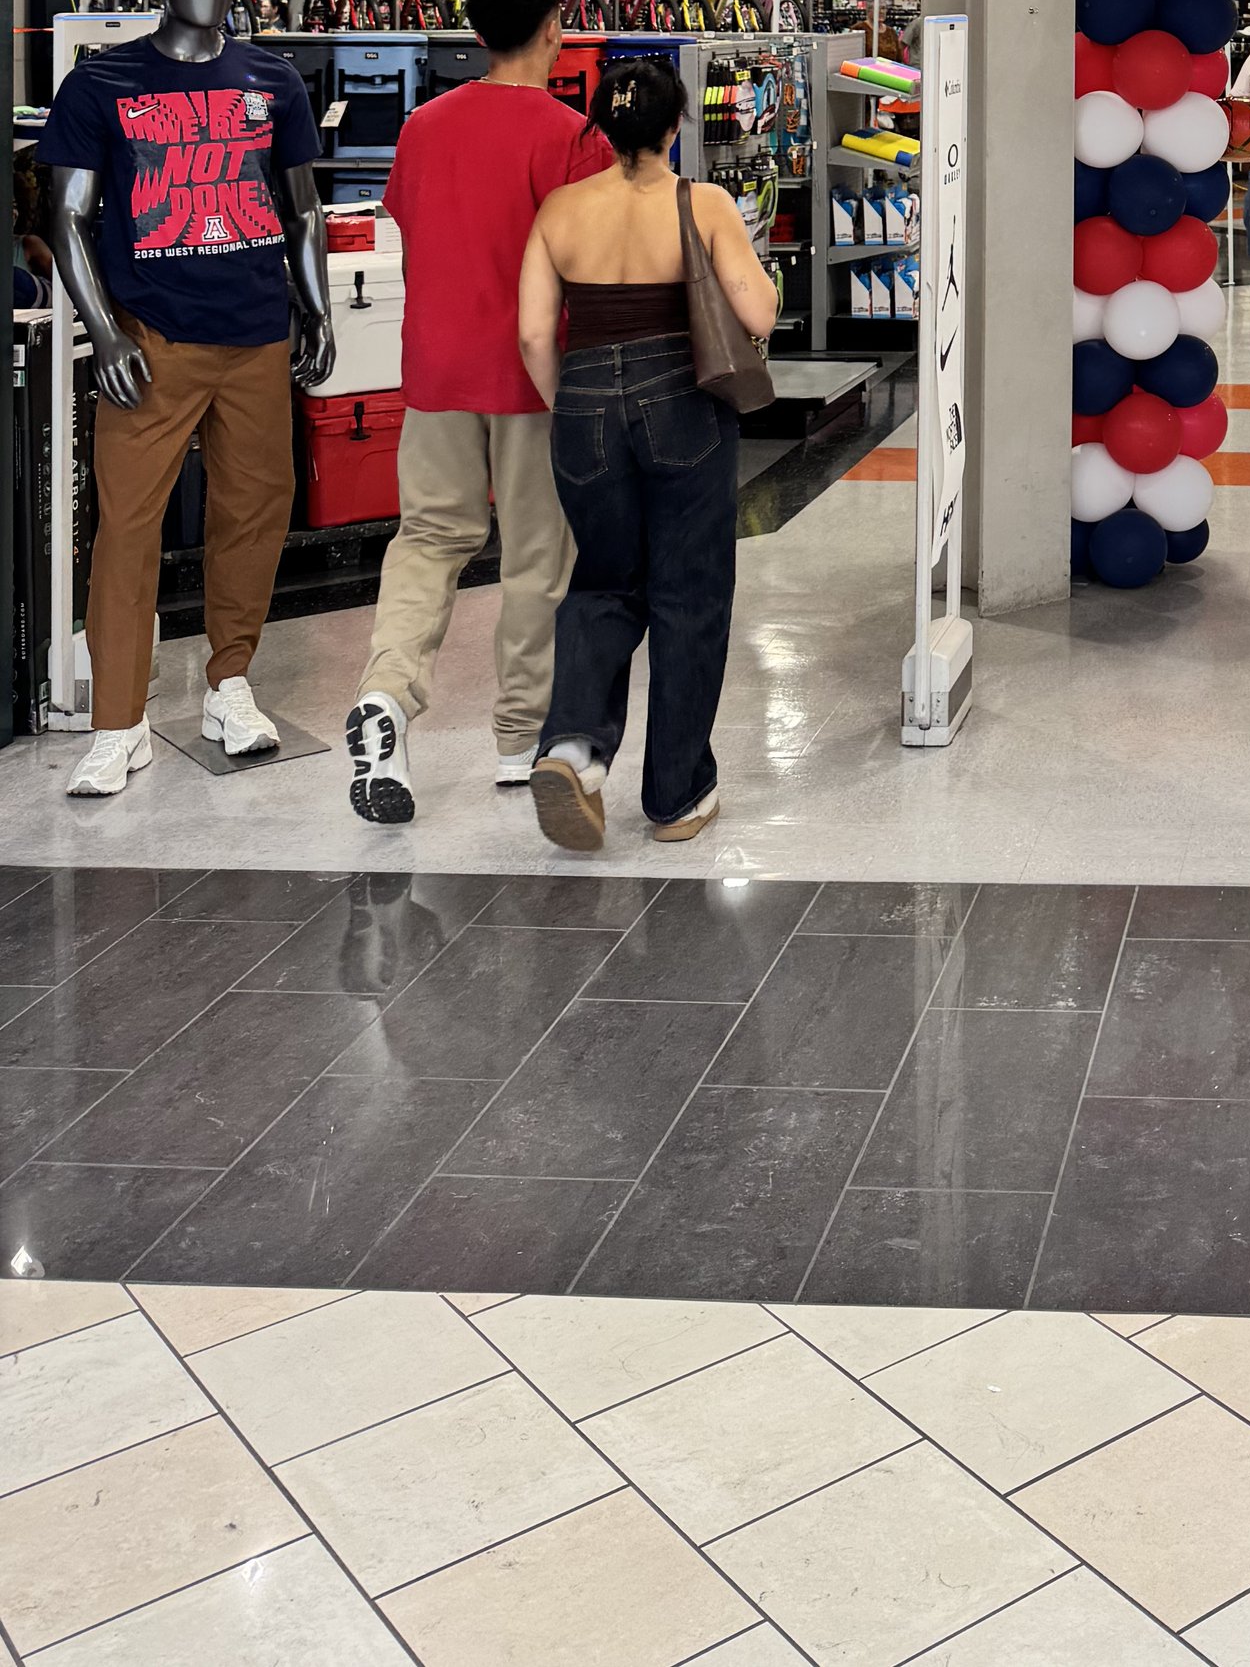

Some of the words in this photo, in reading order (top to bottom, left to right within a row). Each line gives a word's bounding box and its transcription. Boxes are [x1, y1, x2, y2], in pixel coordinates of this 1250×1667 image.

[166, 141, 260, 185] NOT
[134, 248, 162, 260] 2026
[165, 246, 194, 258] WEST
[197, 239, 250, 256] REGIONAL
[251, 234, 286, 248] CHAMPS
